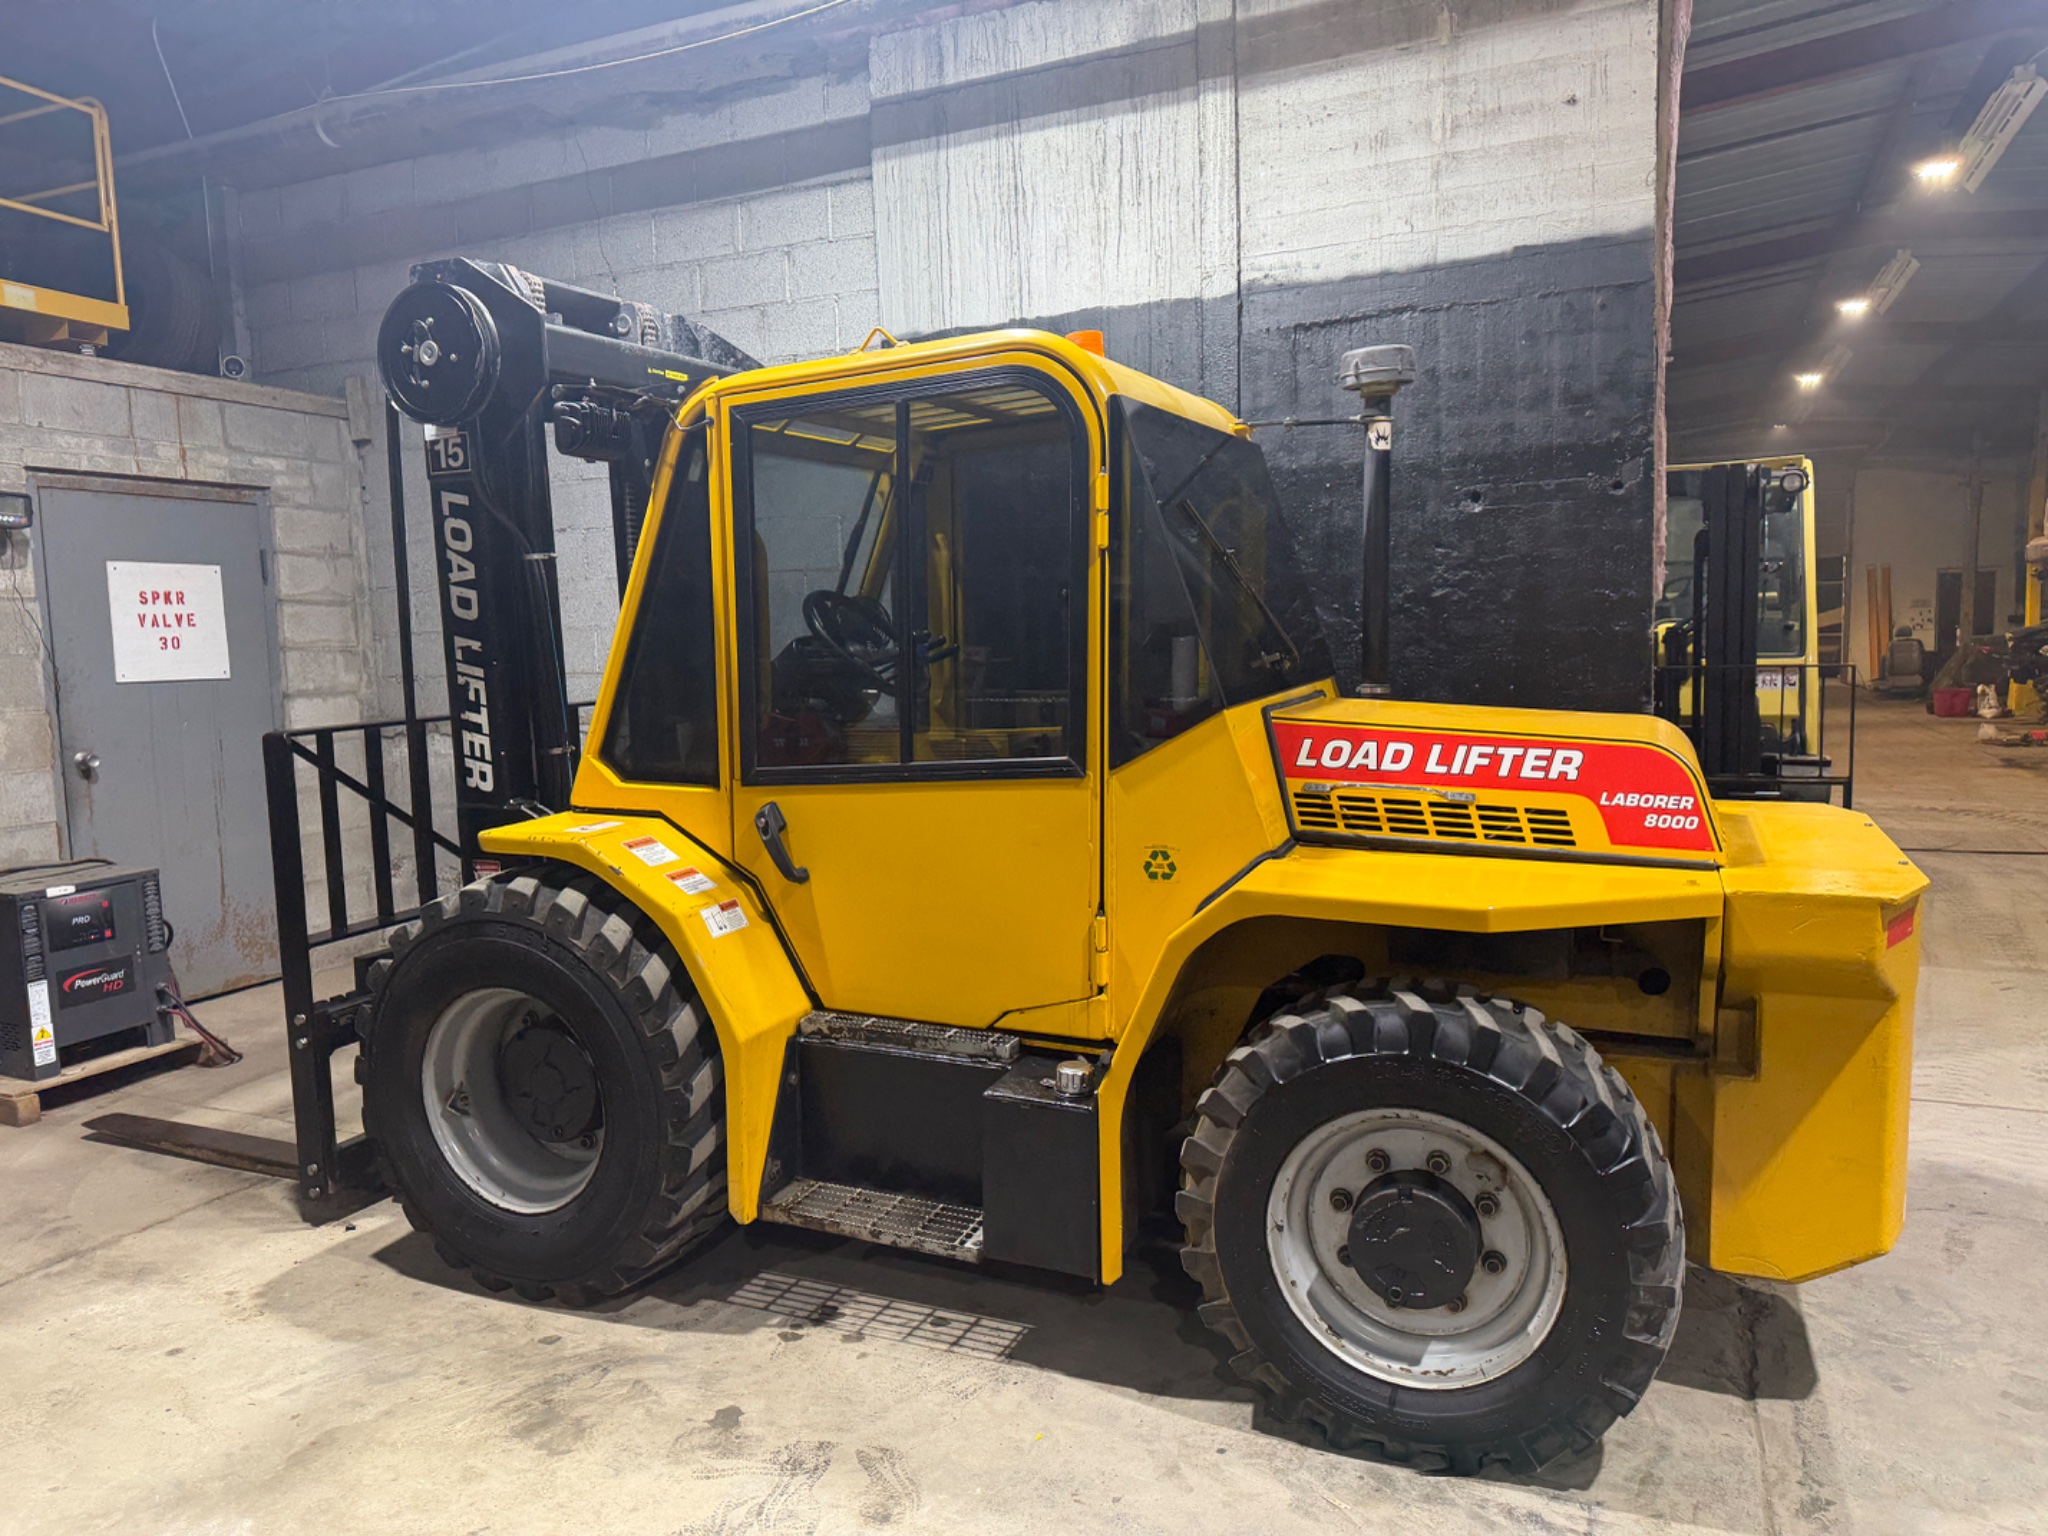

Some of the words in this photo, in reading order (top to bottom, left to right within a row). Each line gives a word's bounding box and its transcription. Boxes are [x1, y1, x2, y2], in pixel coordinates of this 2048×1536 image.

[434, 437, 464, 469] 15
[440, 490, 479, 622] LOAD
[138, 590, 186, 606] SPKR
[137, 612, 197, 628] VALVE
[158, 635, 181, 650] 30
[454, 634, 495, 794] LIFTER
[1296, 738, 1414, 772] LOAD
[1424, 744, 1584, 780] LIFTER
[1600, 792, 1695, 810] LABORER
[1644, 814, 1699, 830] 8000
[72, 915, 92, 926] PRO
[74, 968, 125, 990] PowerGuard
[103, 980, 124, 993] HD
